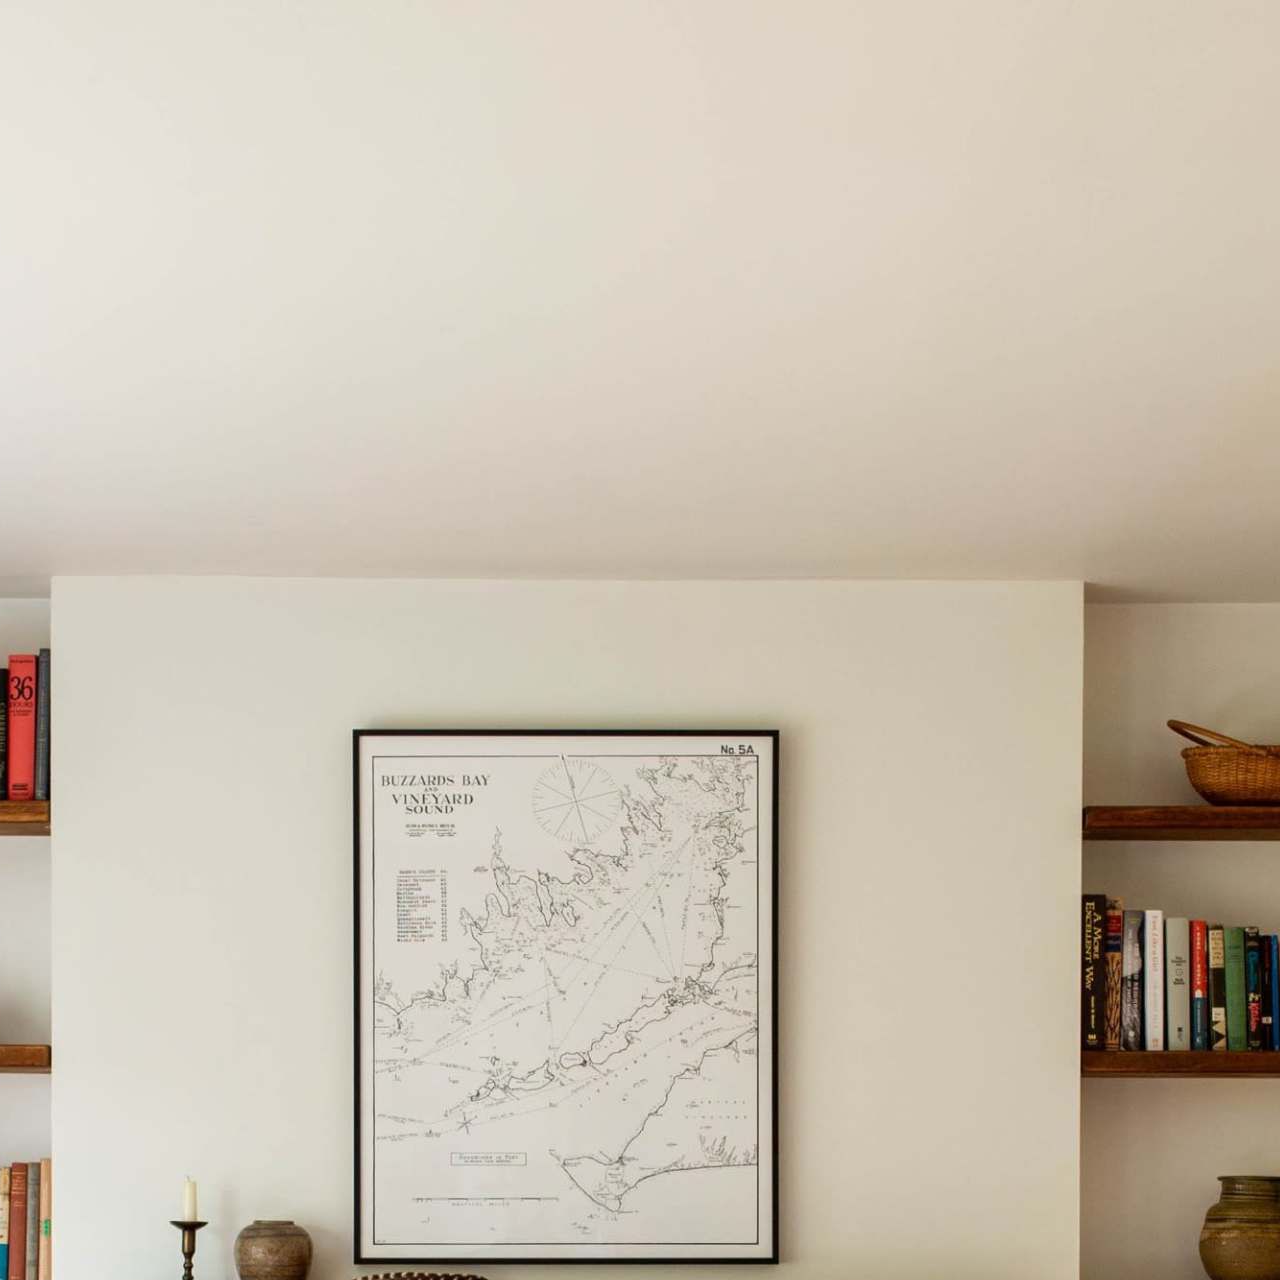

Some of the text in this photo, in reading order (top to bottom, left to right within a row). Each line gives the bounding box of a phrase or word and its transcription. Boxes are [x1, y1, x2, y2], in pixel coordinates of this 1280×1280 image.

[10, 676, 33, 701] 36
[738, 744, 754, 754] 5A
[381, 774, 491, 786] BUZZARDS BAY
[392, 793, 474, 805] VINEYARD
[405, 805, 454, 814] SOUND
[1093, 911, 1102, 921] A
